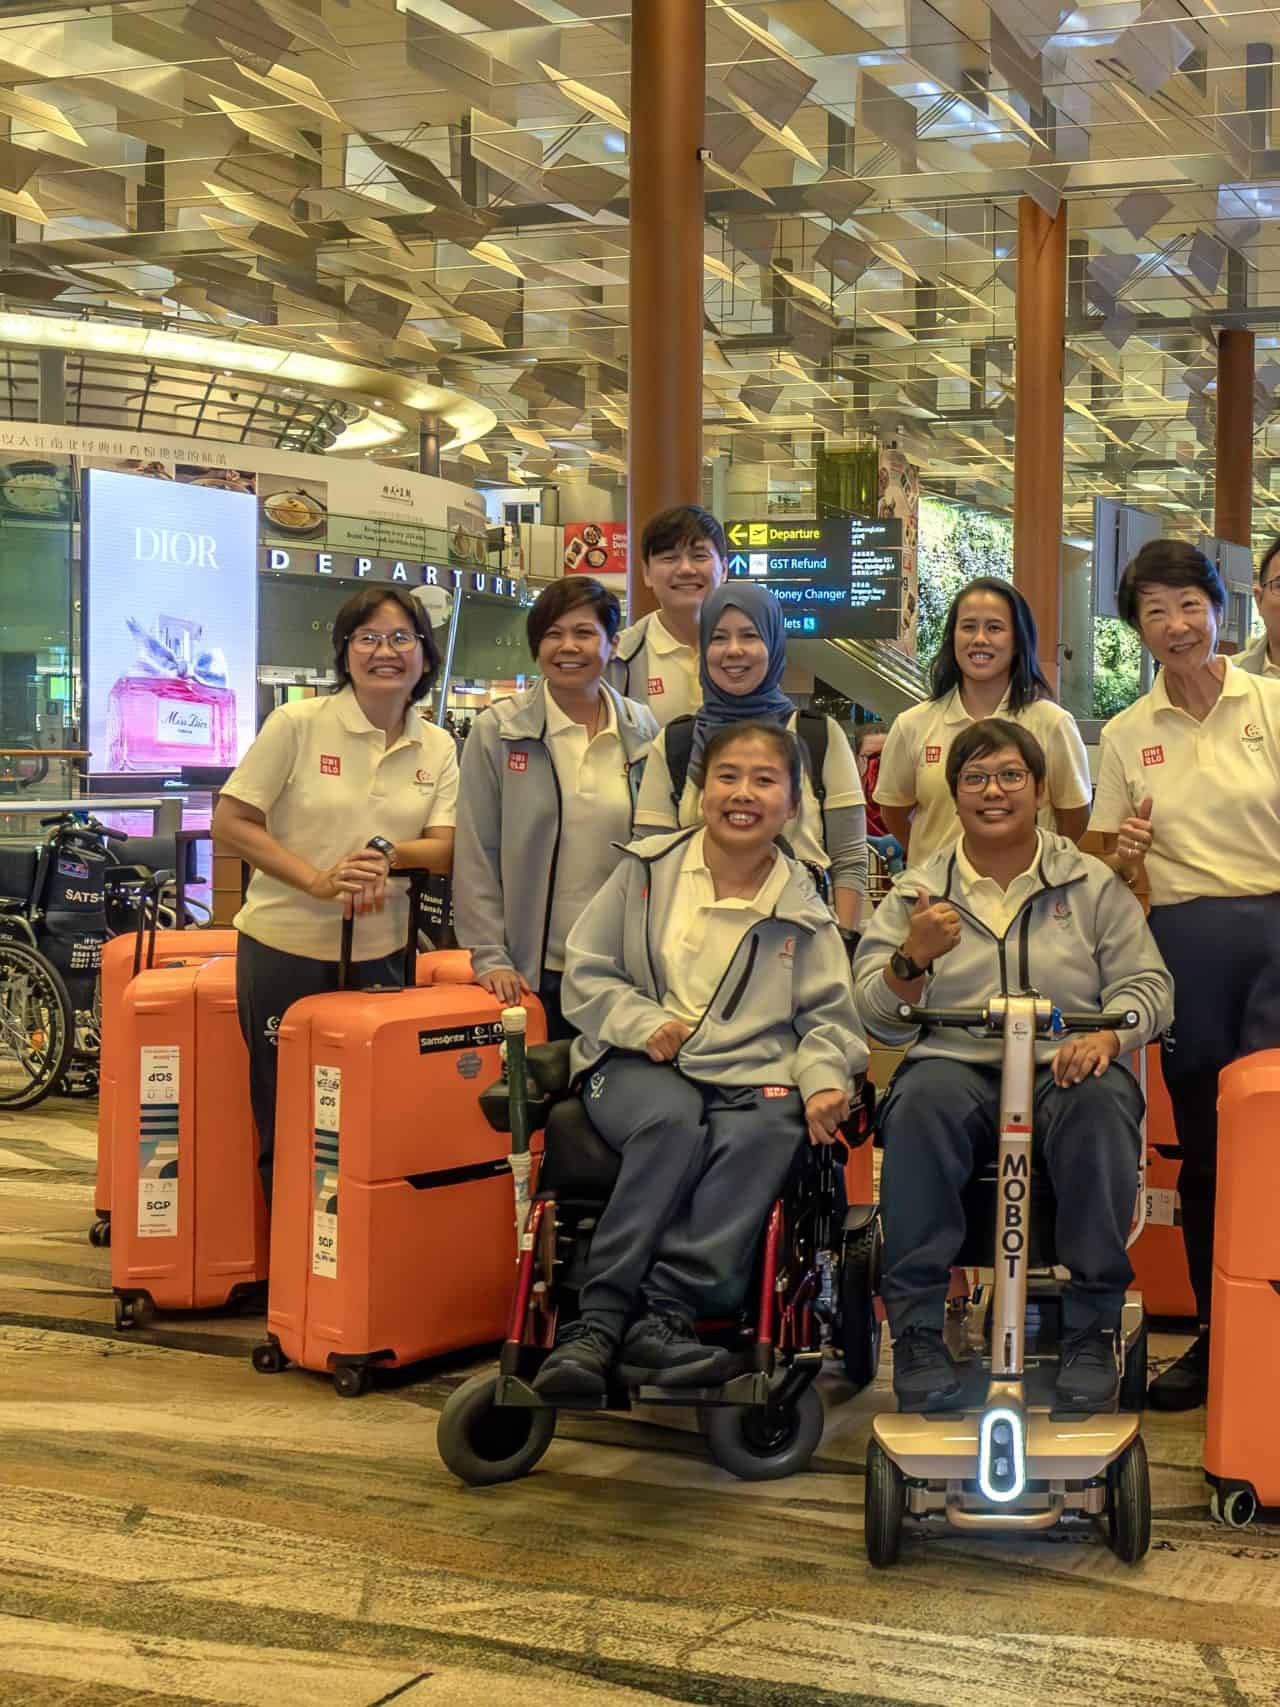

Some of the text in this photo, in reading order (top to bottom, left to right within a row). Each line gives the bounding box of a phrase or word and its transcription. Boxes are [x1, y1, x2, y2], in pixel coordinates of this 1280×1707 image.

[769, 528, 821, 543] Departure
[134, 527, 219, 569] DIOR
[770, 557, 827, 569] GST Refund
[804, 587, 847, 601] Changer
[1144, 748, 1161, 758] UNI
[421, 1034, 465, 1047] Samsonite
[148, 1072, 173, 1082] SGP
[146, 1200, 171, 1211] SGP
[1002, 1153, 1028, 1279] MOBOT
